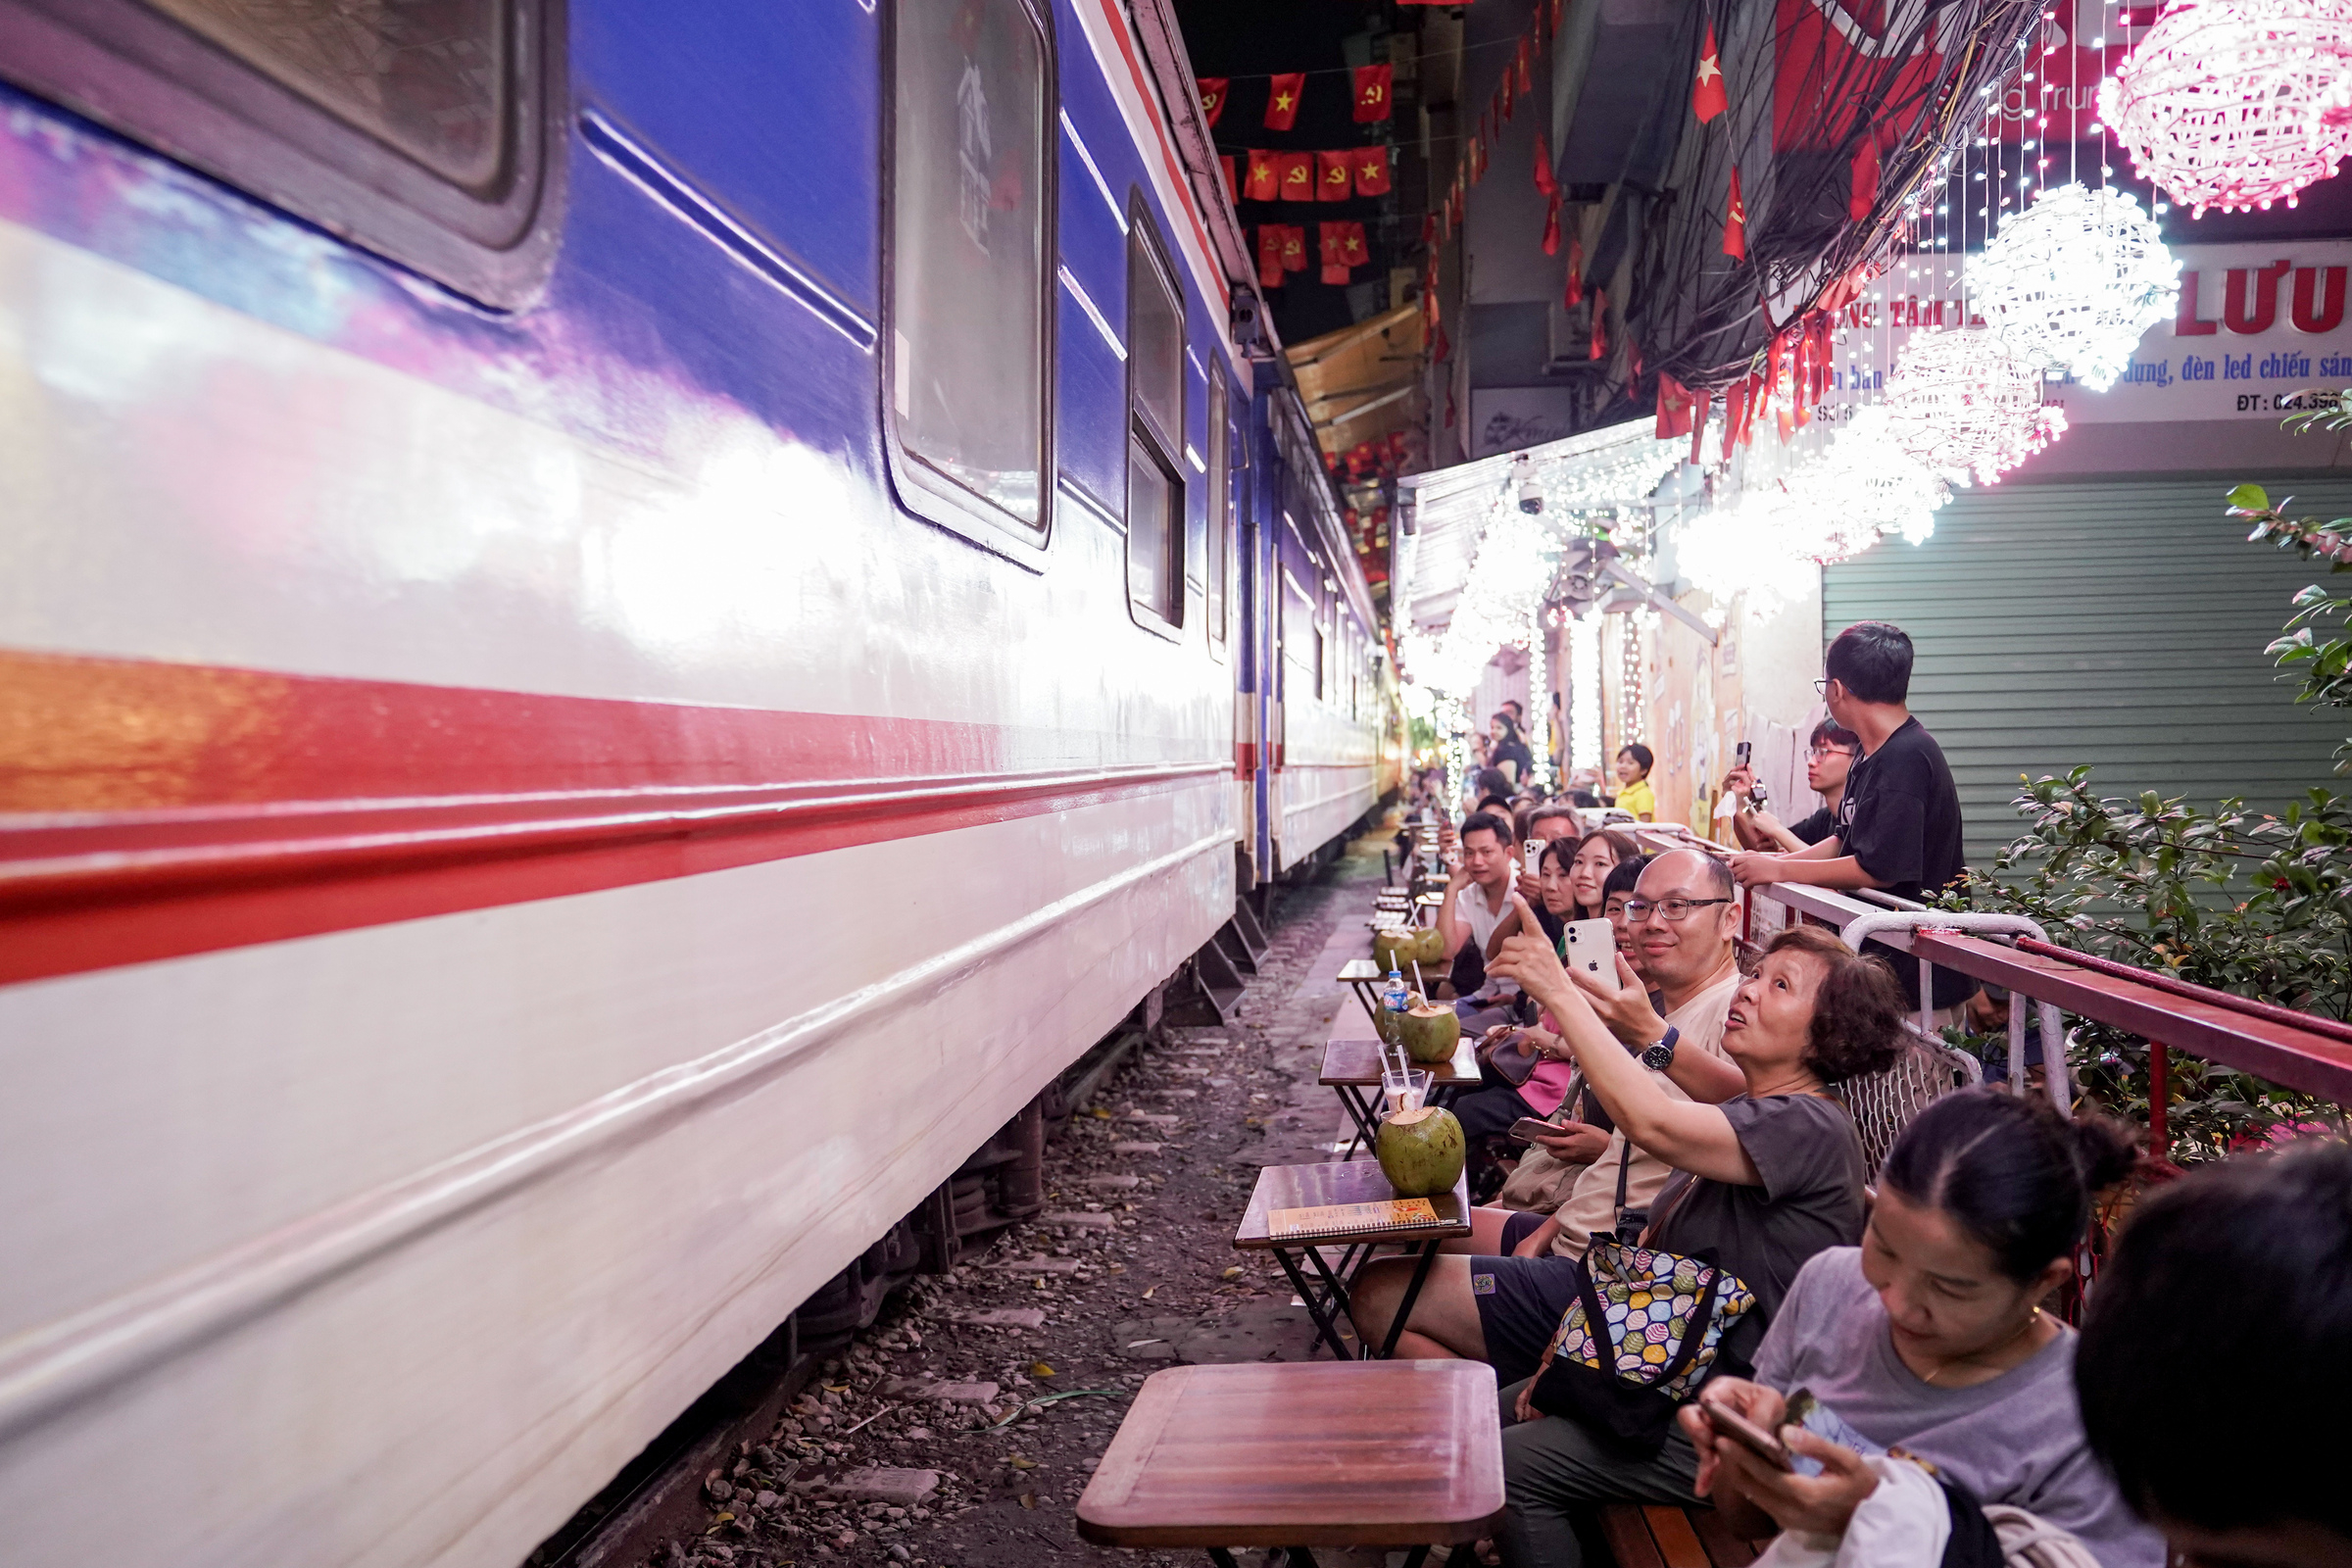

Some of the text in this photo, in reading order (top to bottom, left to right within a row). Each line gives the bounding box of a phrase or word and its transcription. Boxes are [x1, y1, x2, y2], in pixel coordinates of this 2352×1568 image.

[2175, 259, 2349, 337] LƯU
[2181, 354, 2216, 381] đèn
[2224, 353, 2252, 380] led
[2259, 350, 2312, 379] chiếu
[2319, 351, 2352, 380] sán
